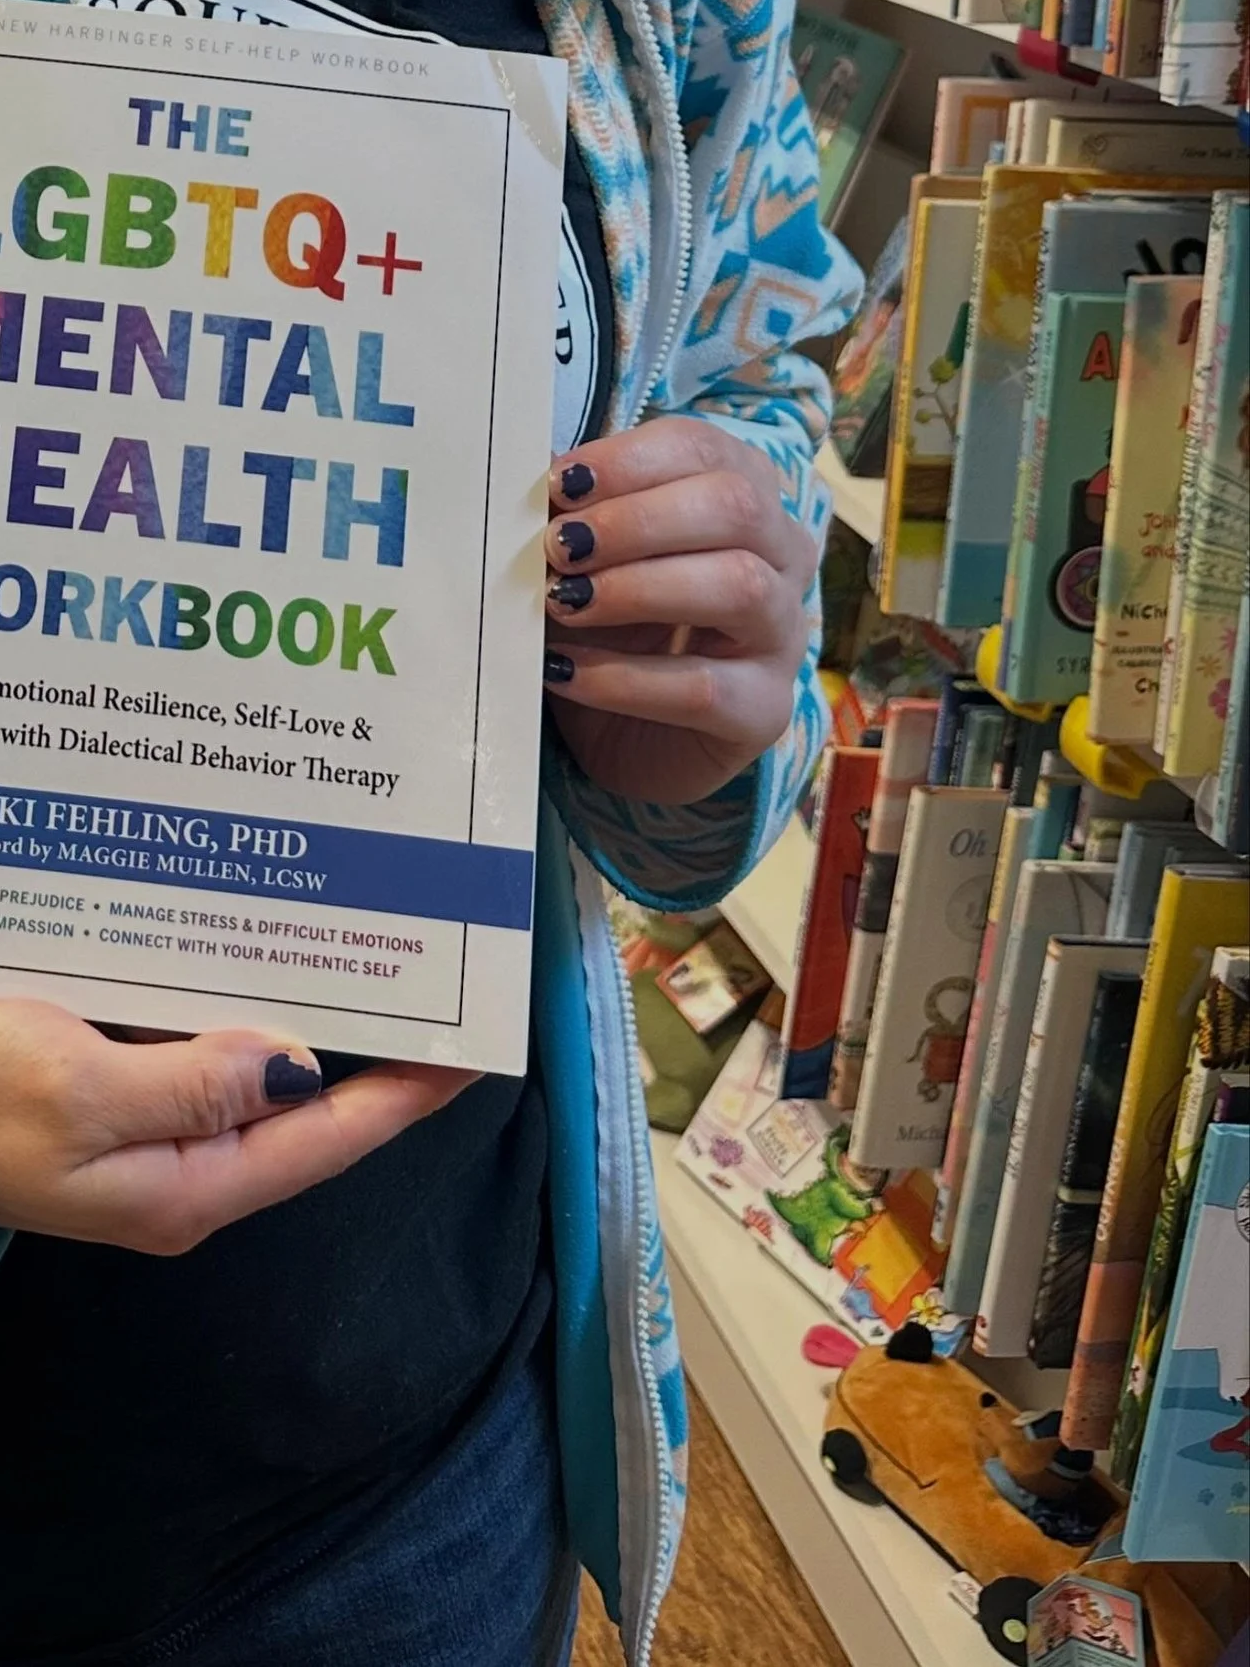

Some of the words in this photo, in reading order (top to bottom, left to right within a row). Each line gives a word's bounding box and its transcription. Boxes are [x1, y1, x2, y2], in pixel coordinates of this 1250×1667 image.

[49, 24, 173, 48] HARBINGER
[185, 37, 301, 62] SELF-HELP
[312, 52, 430, 77] WORKBOOK
[128, 97, 253, 158] THE
[102, 686, 228, 728] Resilience,
[234, 701, 346, 738] Self-Love
[351, 717, 374, 742] &
[0, 722, 52, 750] with
[58, 726, 184, 765] Dialectical
[189, 742, 297, 778] Behavior
[302, 755, 401, 798] Therapy
[45, 800, 219, 854] FEHLING,
[227, 822, 309, 860] PHD
[28, 838, 53, 864] by
[56, 842, 151, 871] MAGGIE
[156, 852, 258, 886] MULLEN,
[262, 867, 329, 893] LCSW
[0, 888, 86, 912] PREJUDICE
[109, 901, 176, 923] MANAGE
[179, 910, 238, 931] STRESS
[241, 917, 254, 934] &
[257, 920, 339, 944] DIFFICULT
[342, 931, 424, 955] EMOTIONS
[98, 927, 174, 951] CONNECT
[177, 939, 217, 956] WITH
[221, 943, 264, 962] YOUR
[268, 948, 359, 974] AUTHENTIC
[361, 961, 402, 979] SELF
